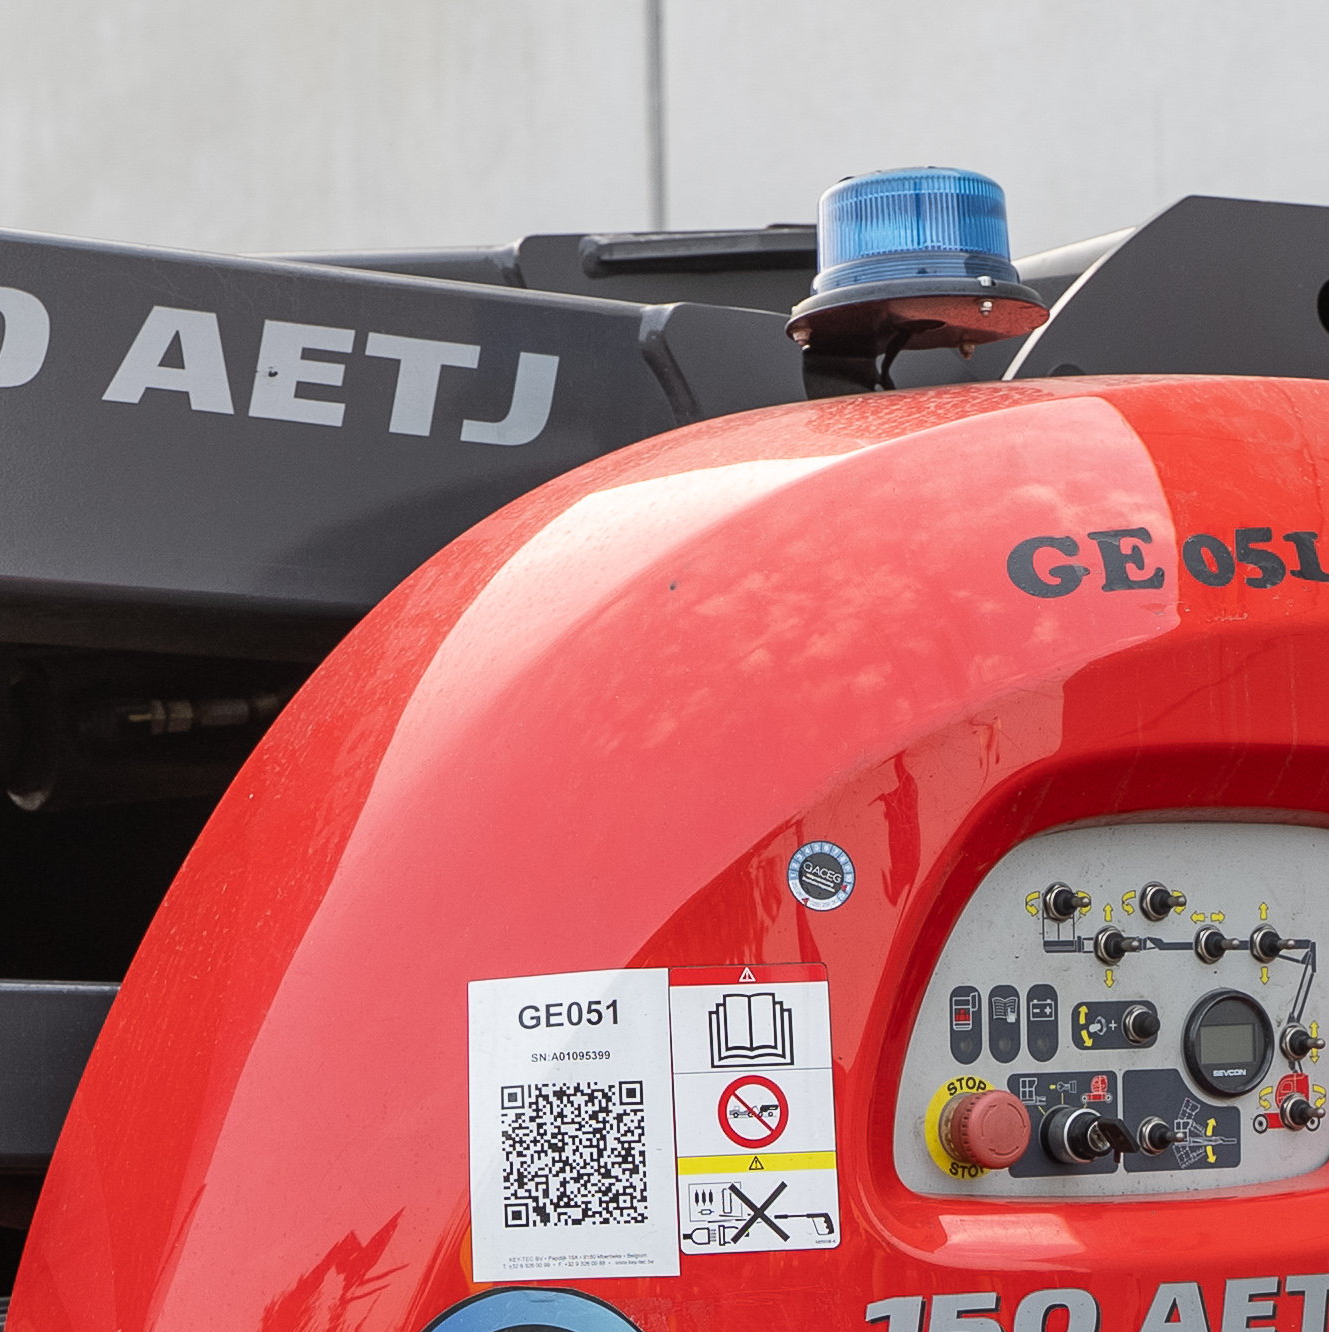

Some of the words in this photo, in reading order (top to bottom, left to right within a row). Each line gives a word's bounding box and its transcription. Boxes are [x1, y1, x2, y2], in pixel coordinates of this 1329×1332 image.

[102, 305, 560, 446] AETJ
[1007, 527, 1165, 599] GE
[518, 999, 619, 1030] GE051
[947, 1076, 987, 1097] STOP
[1212, 1068, 1247, 1078] SEVCON
